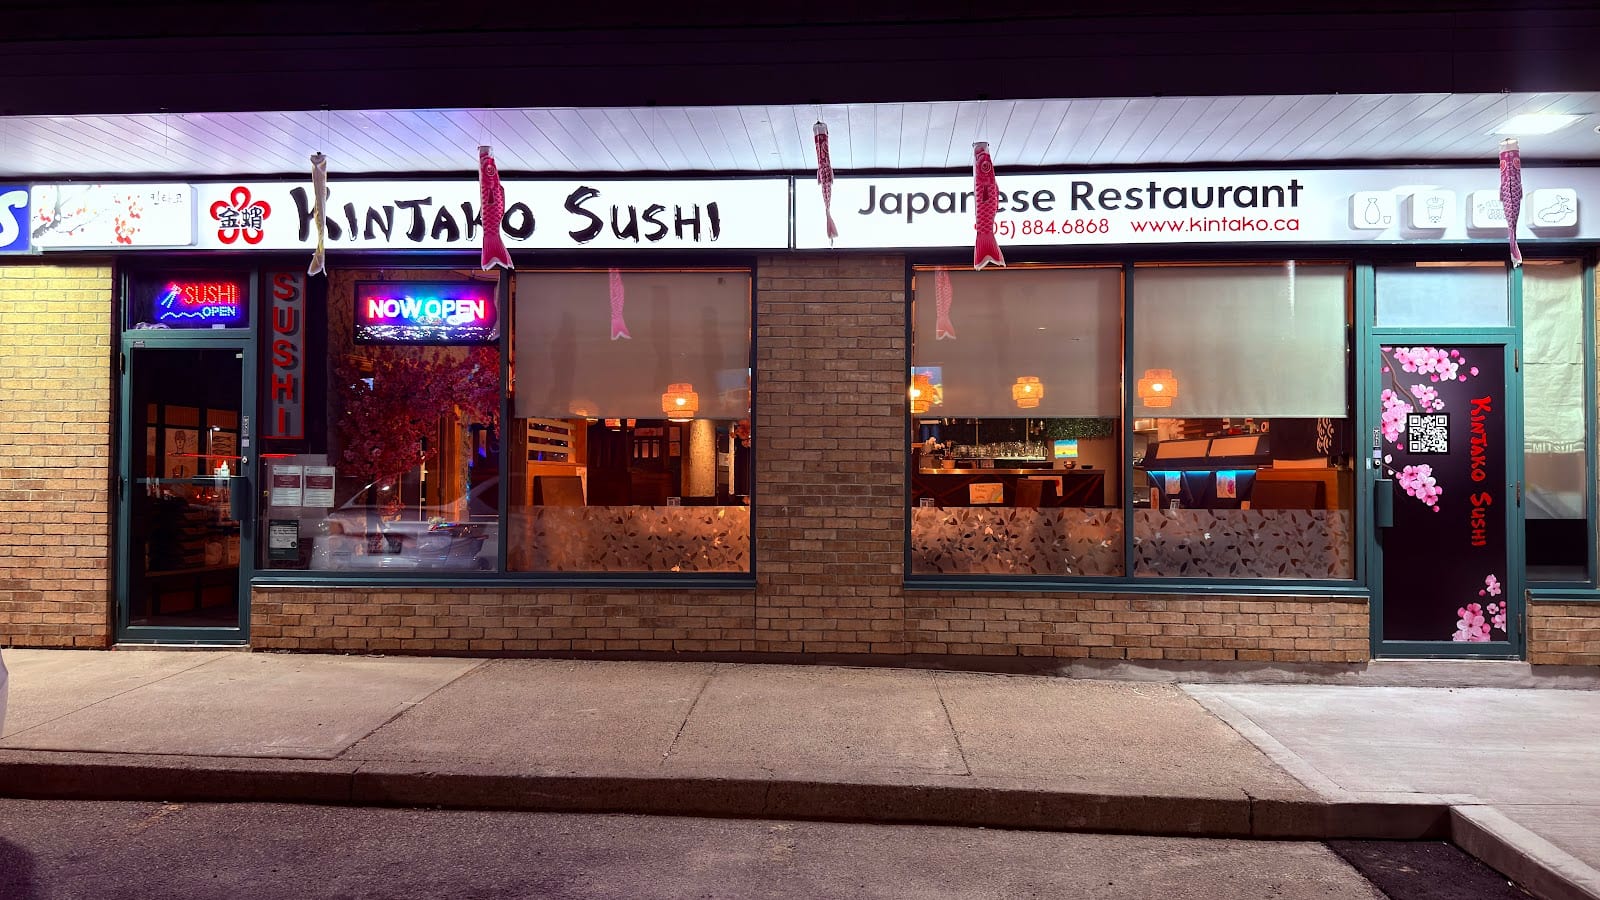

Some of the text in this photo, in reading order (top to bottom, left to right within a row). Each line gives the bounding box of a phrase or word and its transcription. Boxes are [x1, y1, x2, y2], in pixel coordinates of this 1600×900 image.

[1071, 179, 1304, 211] Restaurant
[289, 186, 721, 245] KINTAKO SUSHI
[1021, 218, 1110, 236] 884.6868
[1131, 217, 1301, 234] www.kintako.ca
[184, 285, 236, 304] SUSHI
[202, 306, 236, 317] OPEN
[368, 298, 486, 319] NOW OPEN
[271, 272, 301, 434] SUSHI
[1469, 395, 1492, 547] KINTAKO SUSHI
